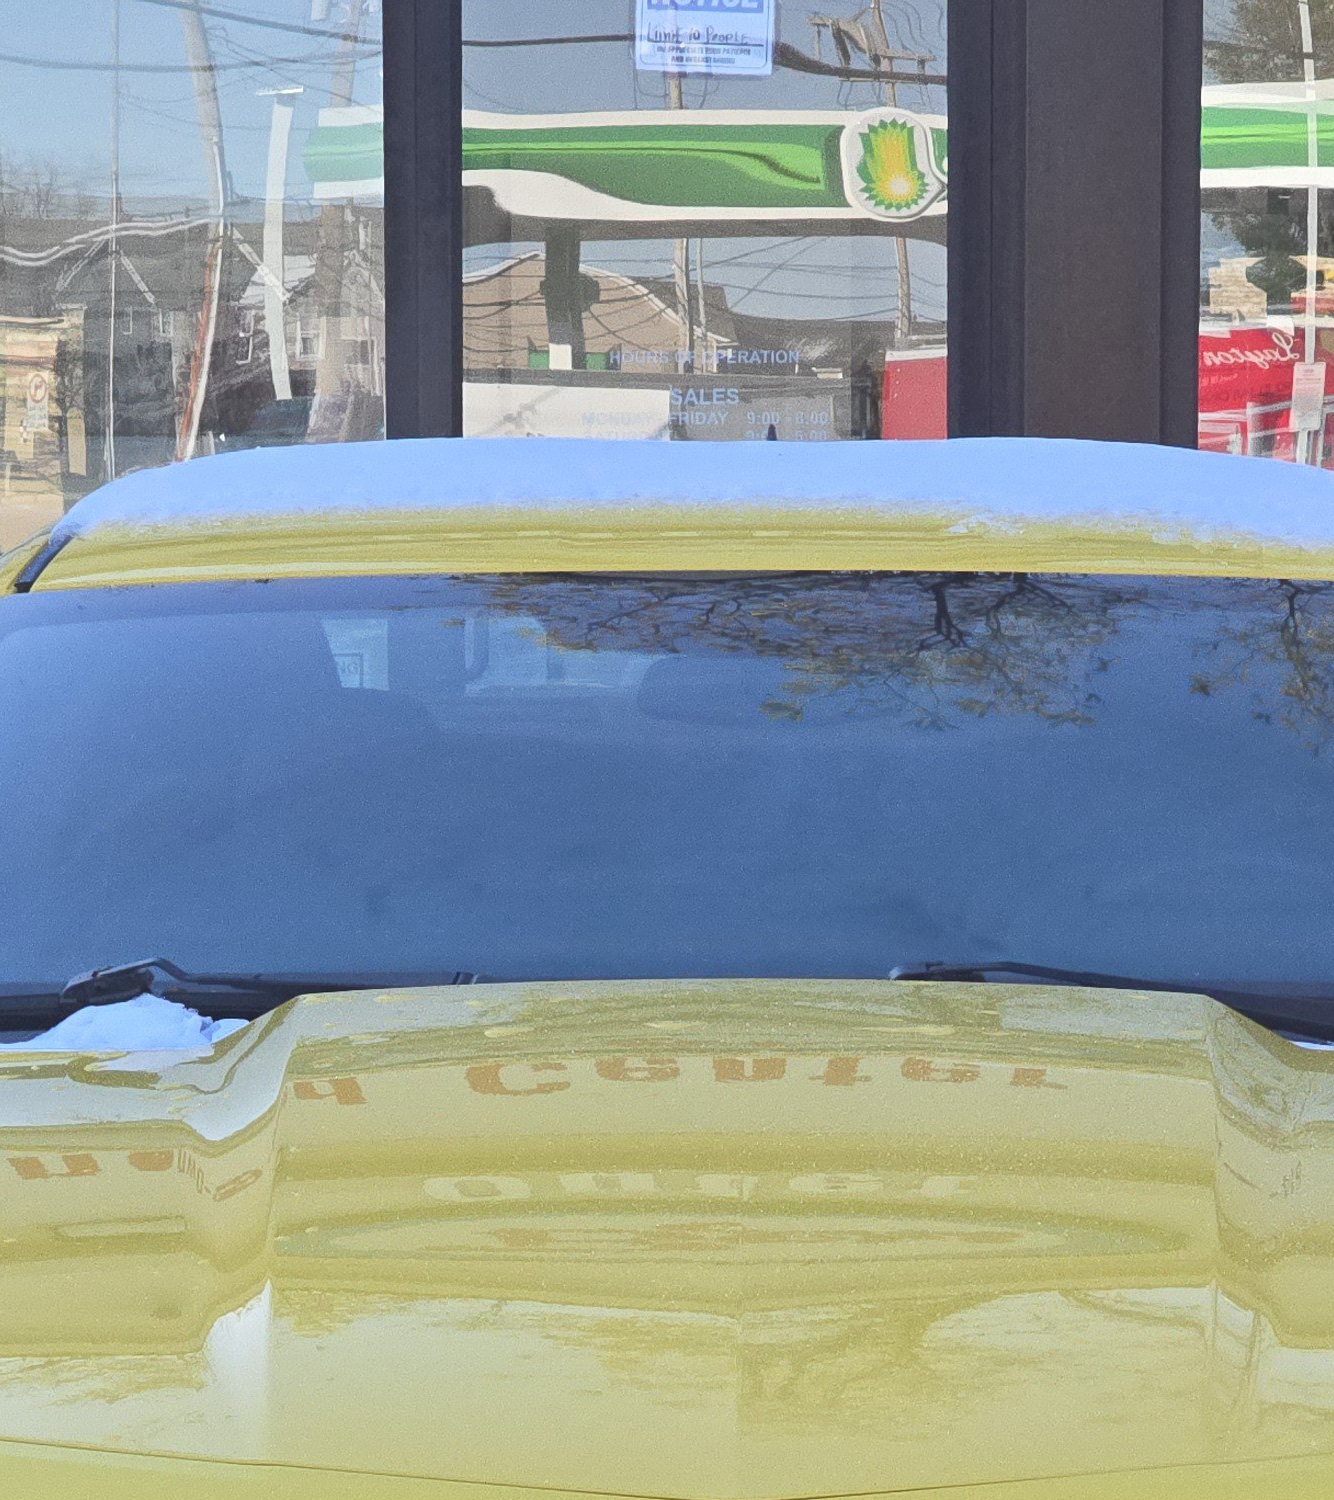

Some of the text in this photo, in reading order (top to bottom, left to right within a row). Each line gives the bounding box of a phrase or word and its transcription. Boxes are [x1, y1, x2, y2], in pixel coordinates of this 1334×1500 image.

[610, 350, 669, 364] HOURS
[703, 349, 800, 364] OPERATION
[669, 387, 740, 405] SALES
